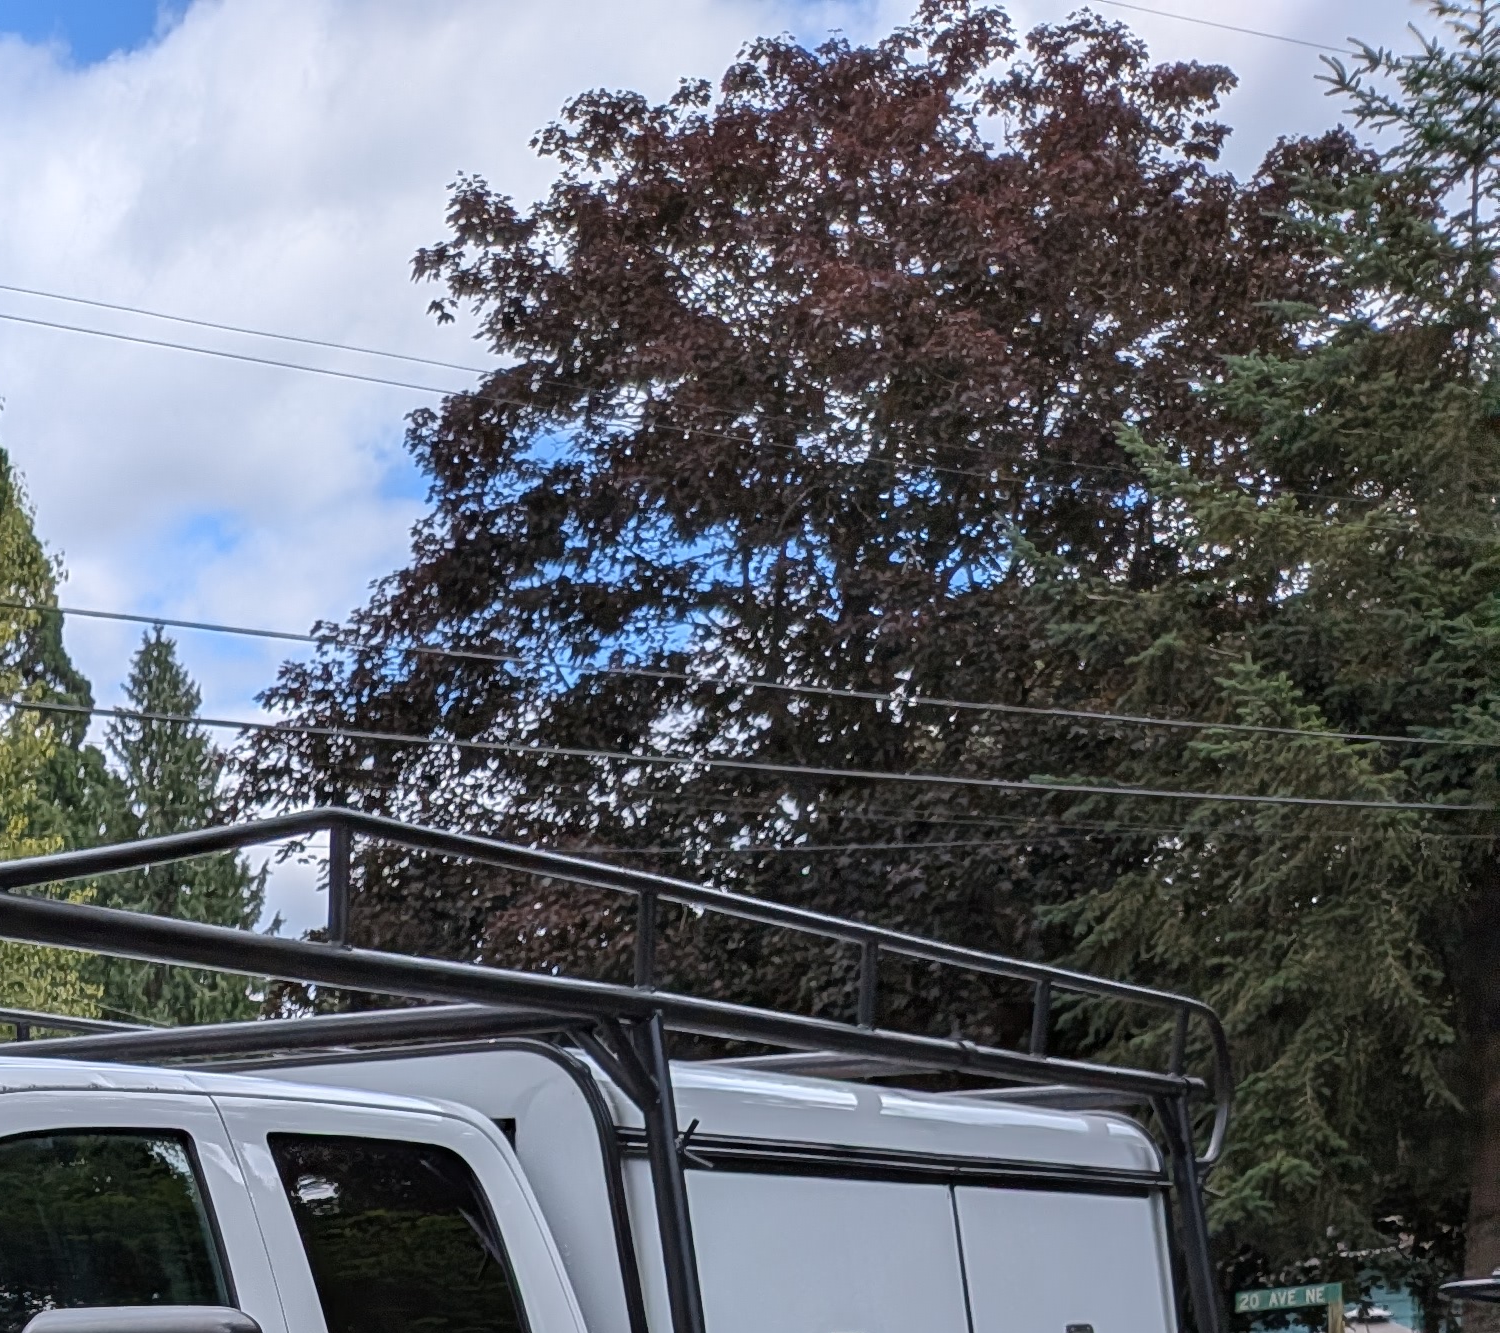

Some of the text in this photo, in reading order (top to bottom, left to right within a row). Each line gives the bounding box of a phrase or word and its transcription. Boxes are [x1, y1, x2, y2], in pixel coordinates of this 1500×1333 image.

[1239, 1286, 1326, 1311] 20 AVE NE
